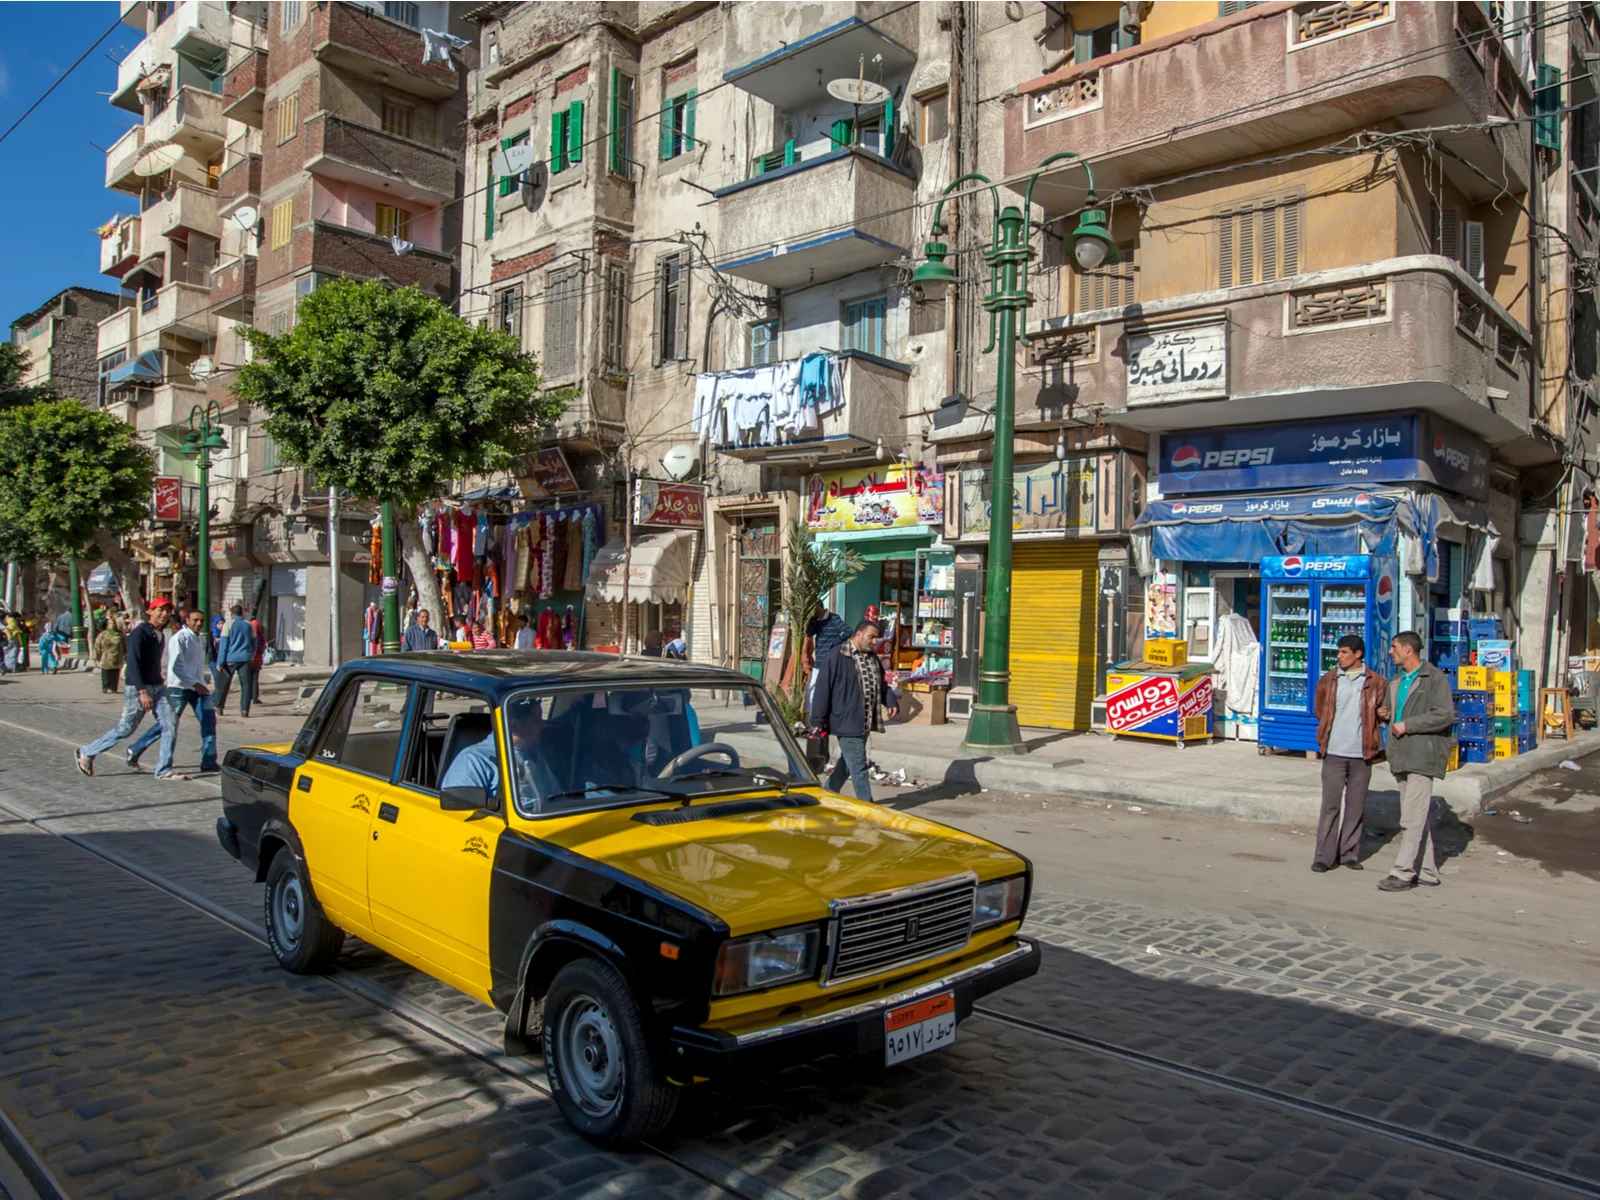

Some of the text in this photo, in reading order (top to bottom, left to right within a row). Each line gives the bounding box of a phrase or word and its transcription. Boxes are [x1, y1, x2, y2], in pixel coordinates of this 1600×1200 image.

[1156, 334, 1195, 350] دكتور
[1309, 427, 1400, 452] بازار كرموز
[1203, 447, 1274, 468] PEPSI
[1446, 447, 1469, 472] PEPSI
[1187, 503, 1223, 515] PEPSI
[1245, 500, 1290, 512] بازار كرموز
[1305, 561, 1347, 571] PEPSI
[1112, 694, 1177, 728] DOLCE
[929, 1000, 948, 1013] مصر
[892, 1010, 915, 1025] EGYPT
[544, 1025, 560, 1091] MAXXIS
